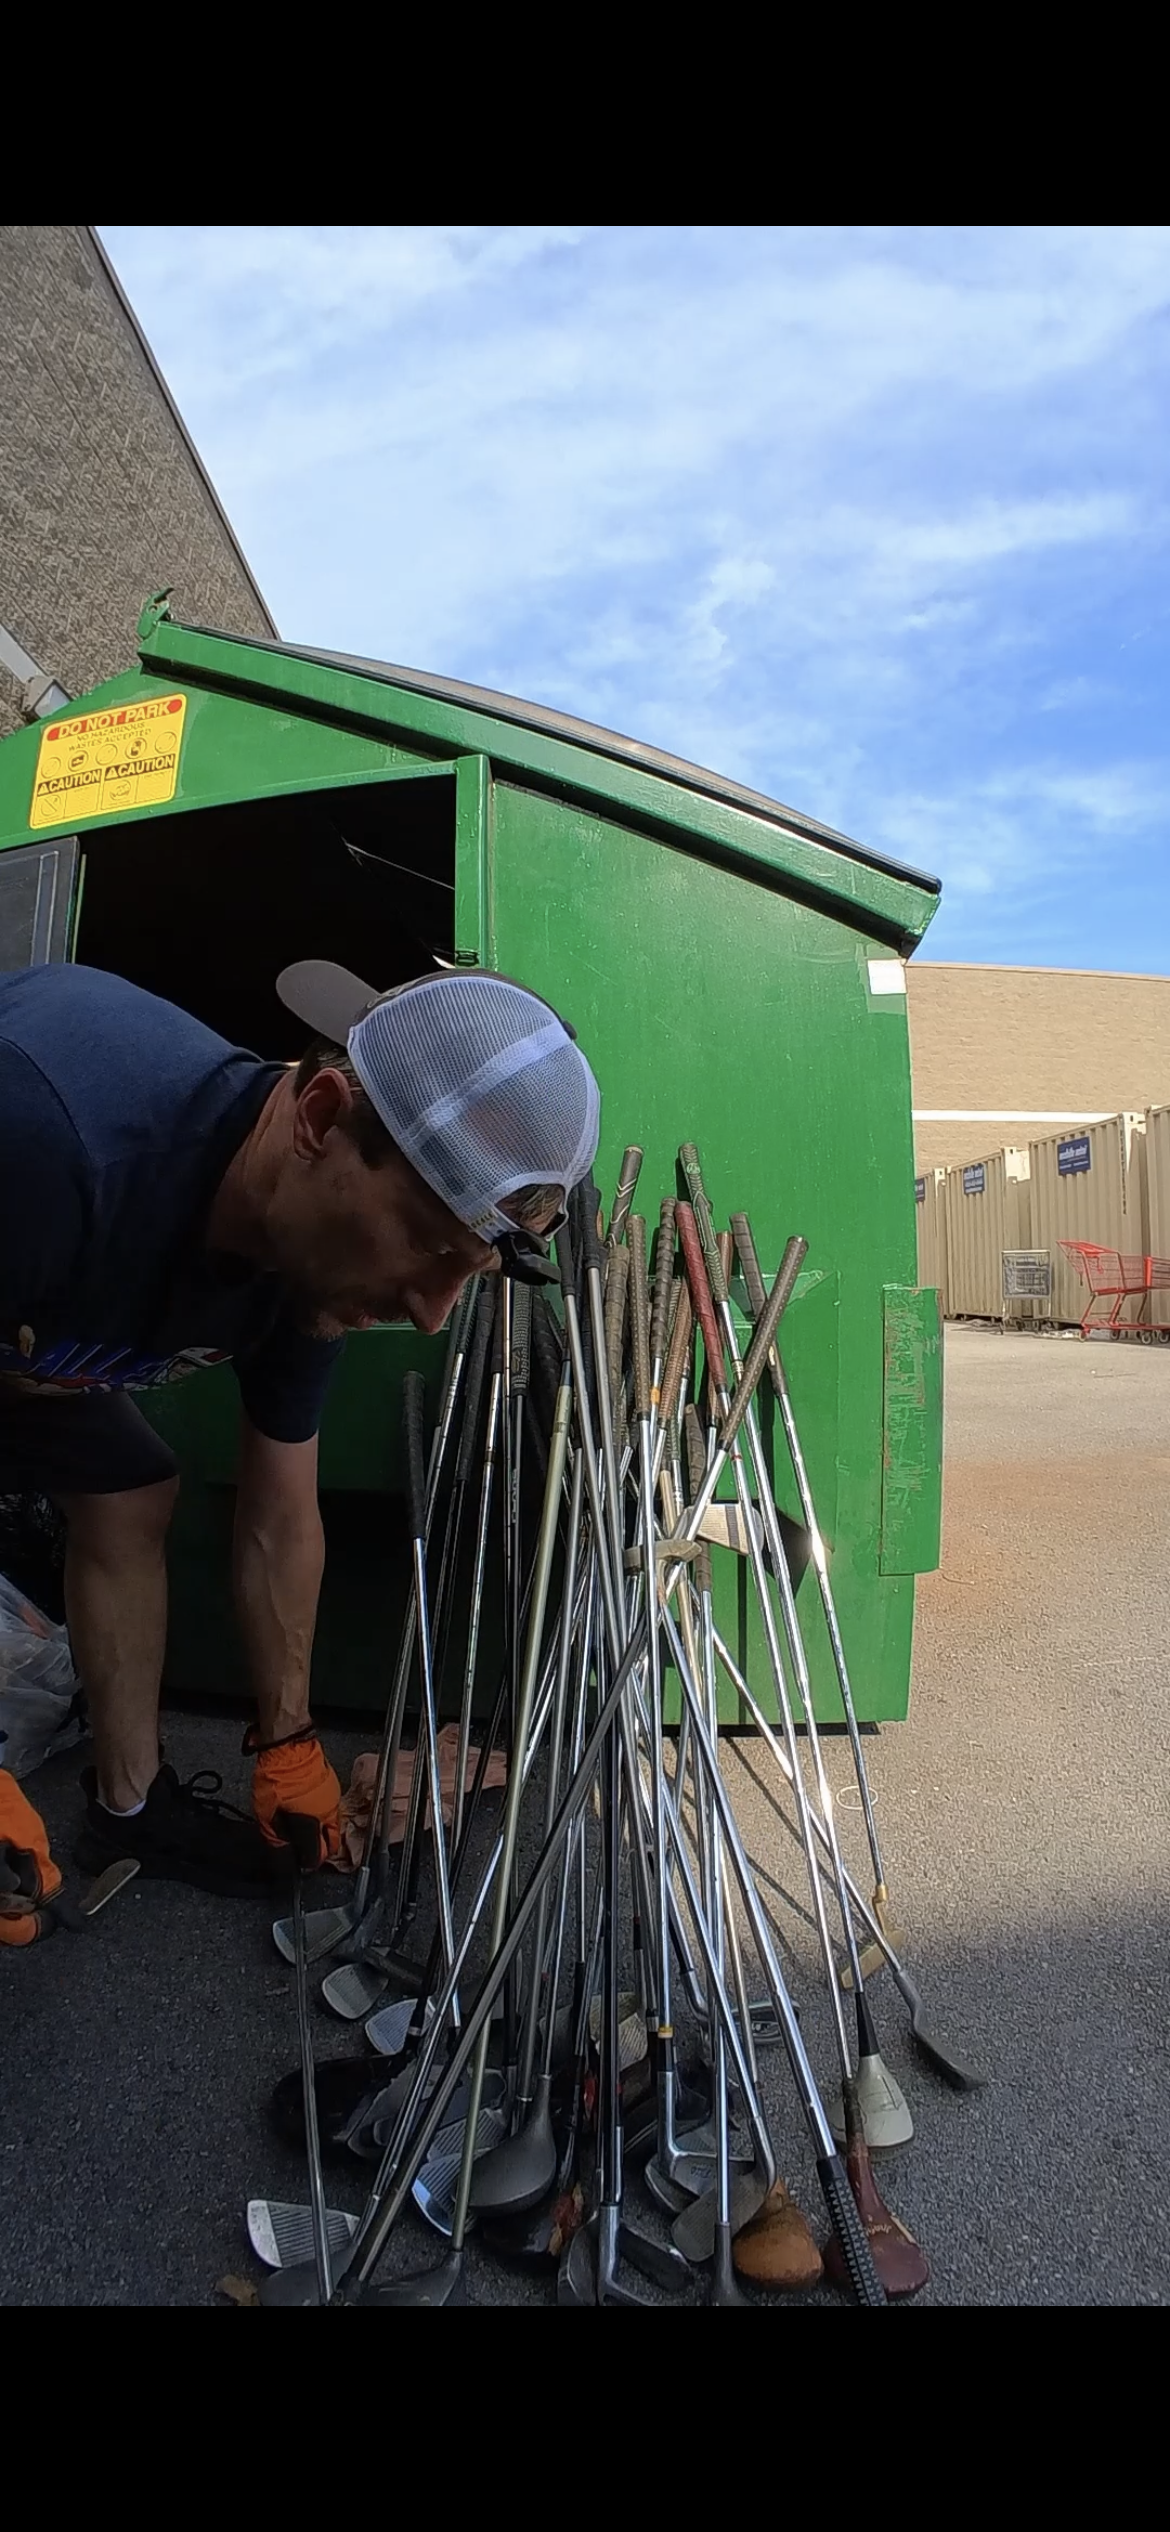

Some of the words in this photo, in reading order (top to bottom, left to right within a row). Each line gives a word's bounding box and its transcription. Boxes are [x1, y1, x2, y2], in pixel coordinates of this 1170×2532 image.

[59, 723, 82, 738] DO
[86, 712, 122, 732] NOT
[126, 703, 169, 719] PARK
[118, 755, 174, 777] CAUTION
[49, 770, 101, 792] CAUTION
